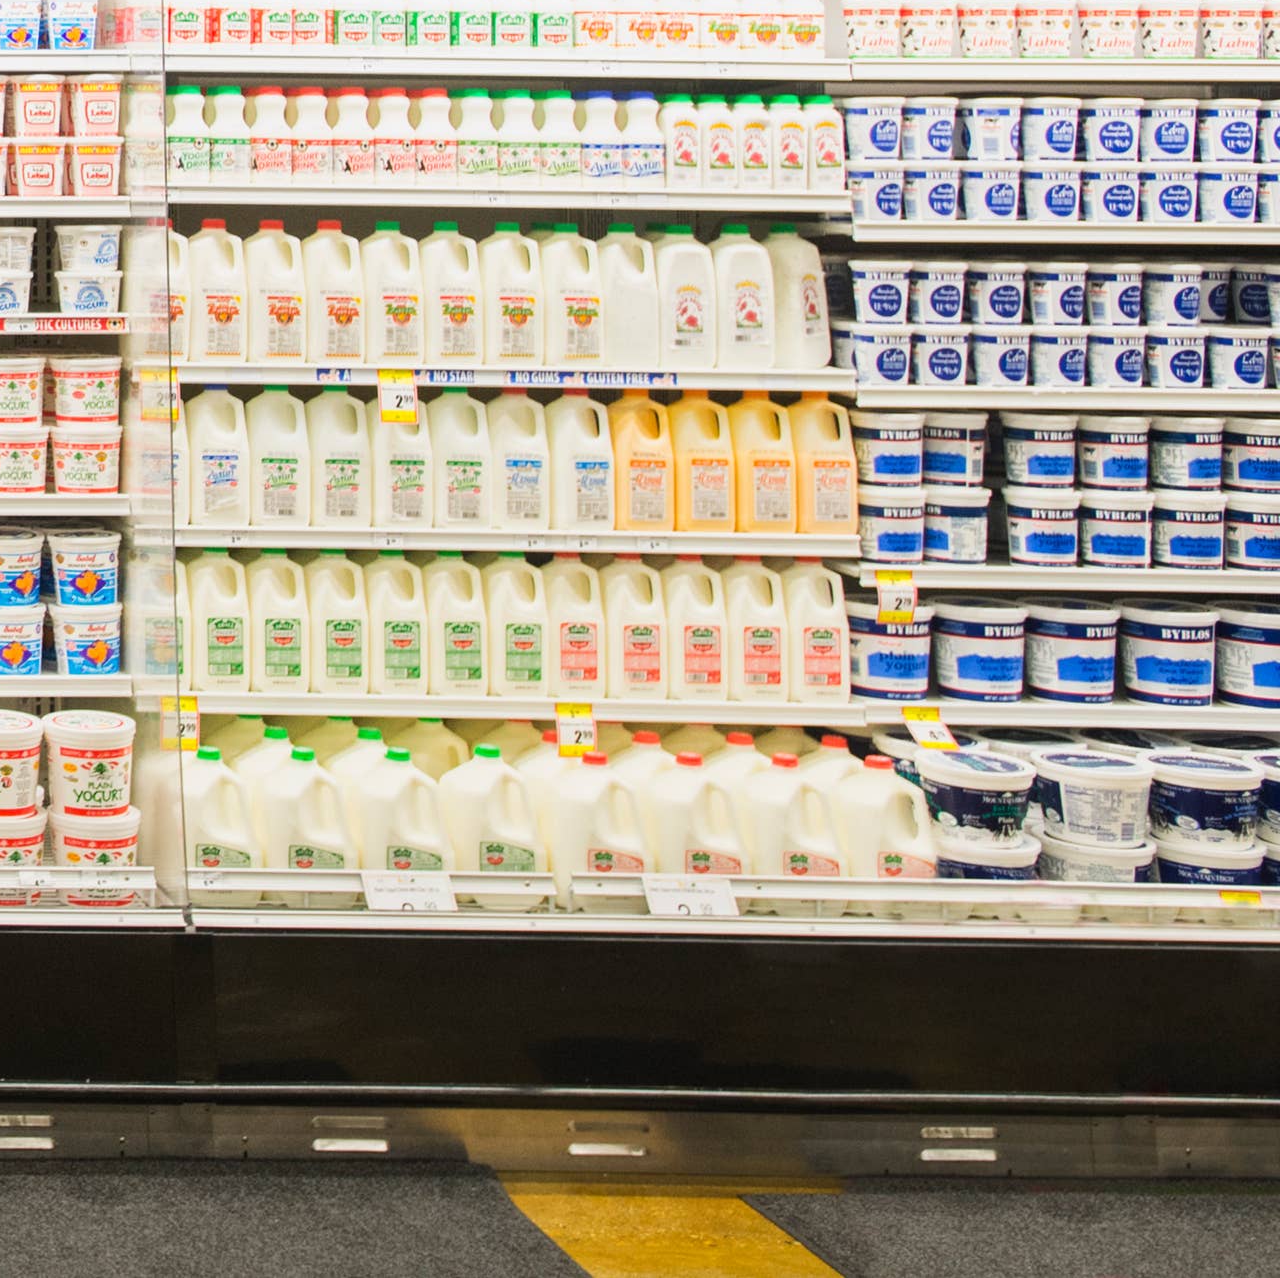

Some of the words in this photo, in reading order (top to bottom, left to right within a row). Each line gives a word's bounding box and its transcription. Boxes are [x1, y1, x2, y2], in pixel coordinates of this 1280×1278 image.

[54, 319, 102, 331] CULTURES
[434, 371, 448, 381] NO
[516, 372, 529, 383] NO
[531, 372, 560, 383] GUMS
[587, 373, 623, 384] GLUTEN
[626, 373, 649, 384] FREE
[880, 430, 920, 440] BYBLOS
[1034, 431, 1074, 441] BYBLOS
[884, 507, 922, 517] BYBLOS
[1031, 509, 1074, 519] BYBLOS
[1095, 510, 1142, 521] BYBLOS
[1176, 511, 1220, 522] BYBLOS
[1161, 627, 1211, 640] BYBLOS
[879, 652, 916, 663] plain
[73, 787, 124, 803] YOGURT
